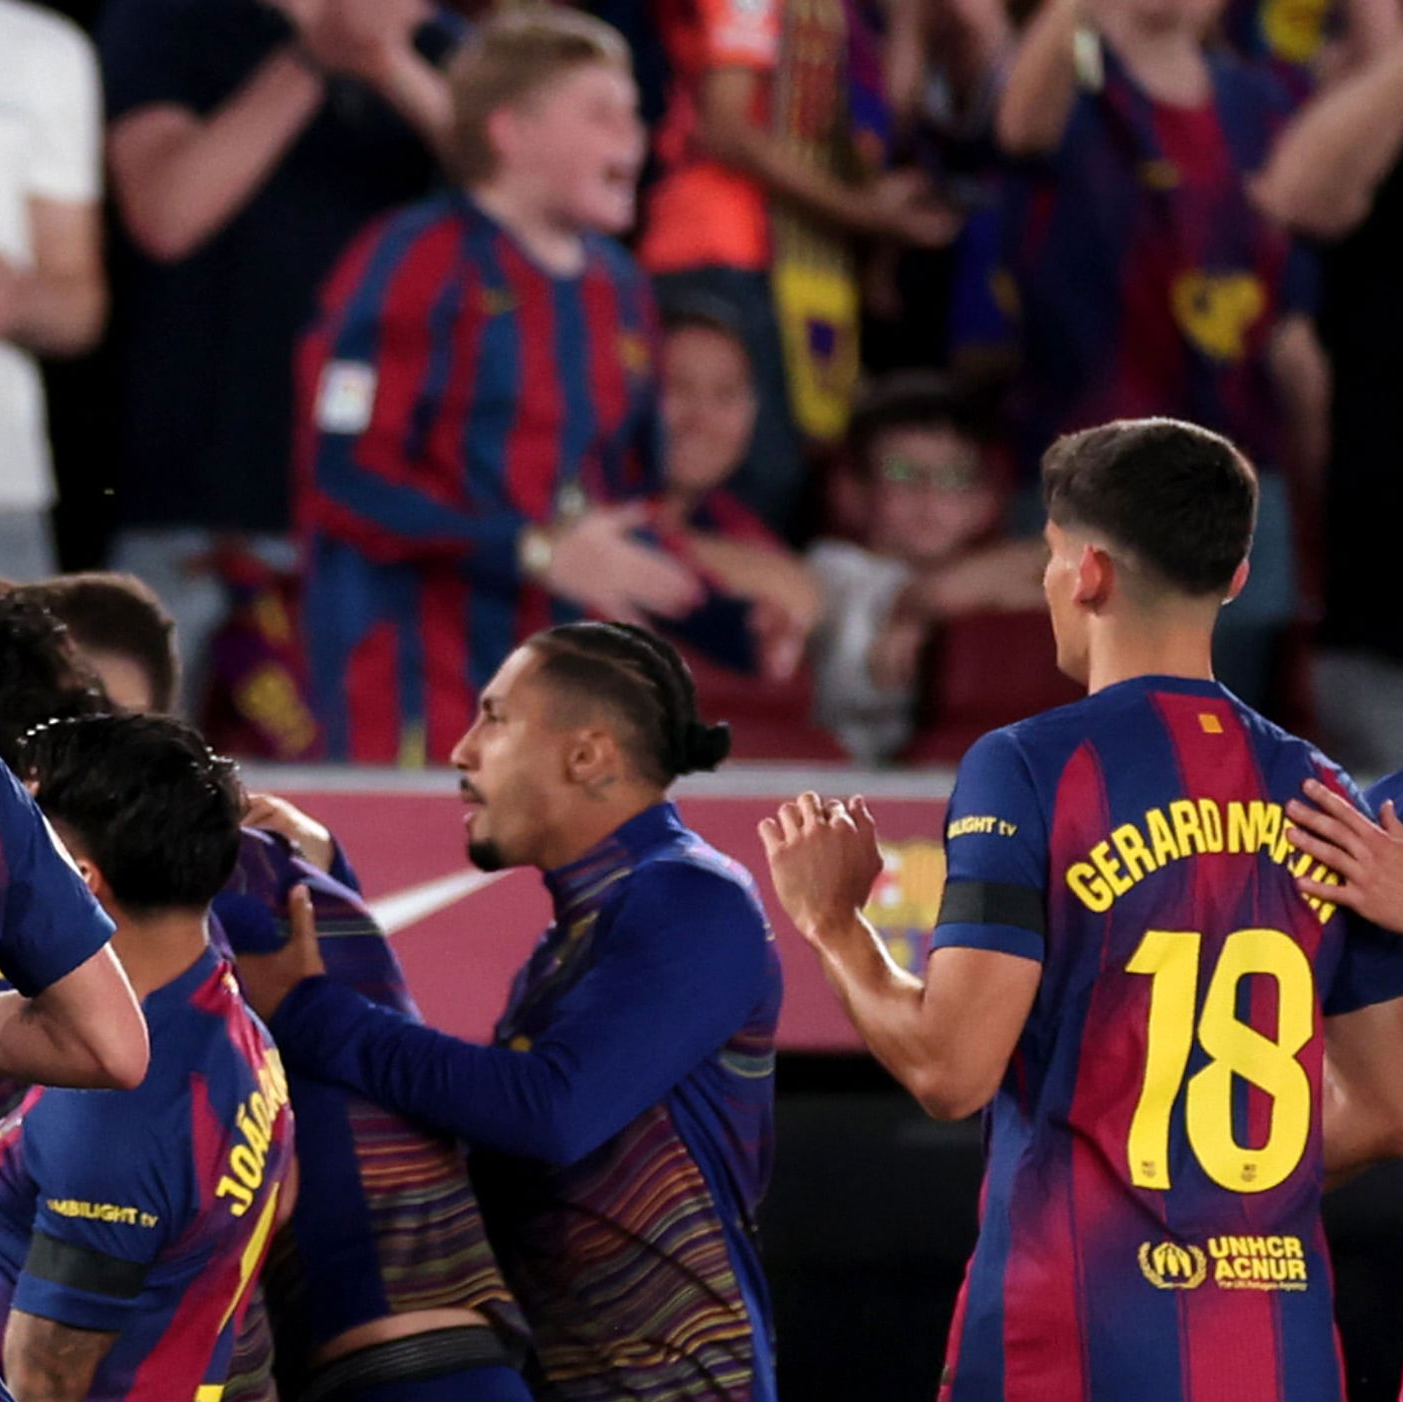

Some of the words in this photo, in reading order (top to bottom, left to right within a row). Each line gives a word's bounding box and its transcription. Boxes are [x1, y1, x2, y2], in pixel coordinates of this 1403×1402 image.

[1065, 798, 1224, 913] GERARD
[1125, 927, 1315, 1194] 18
[1208, 1235, 1304, 1258] UNHCR
[1214, 1257, 1307, 1281] ACNUR
